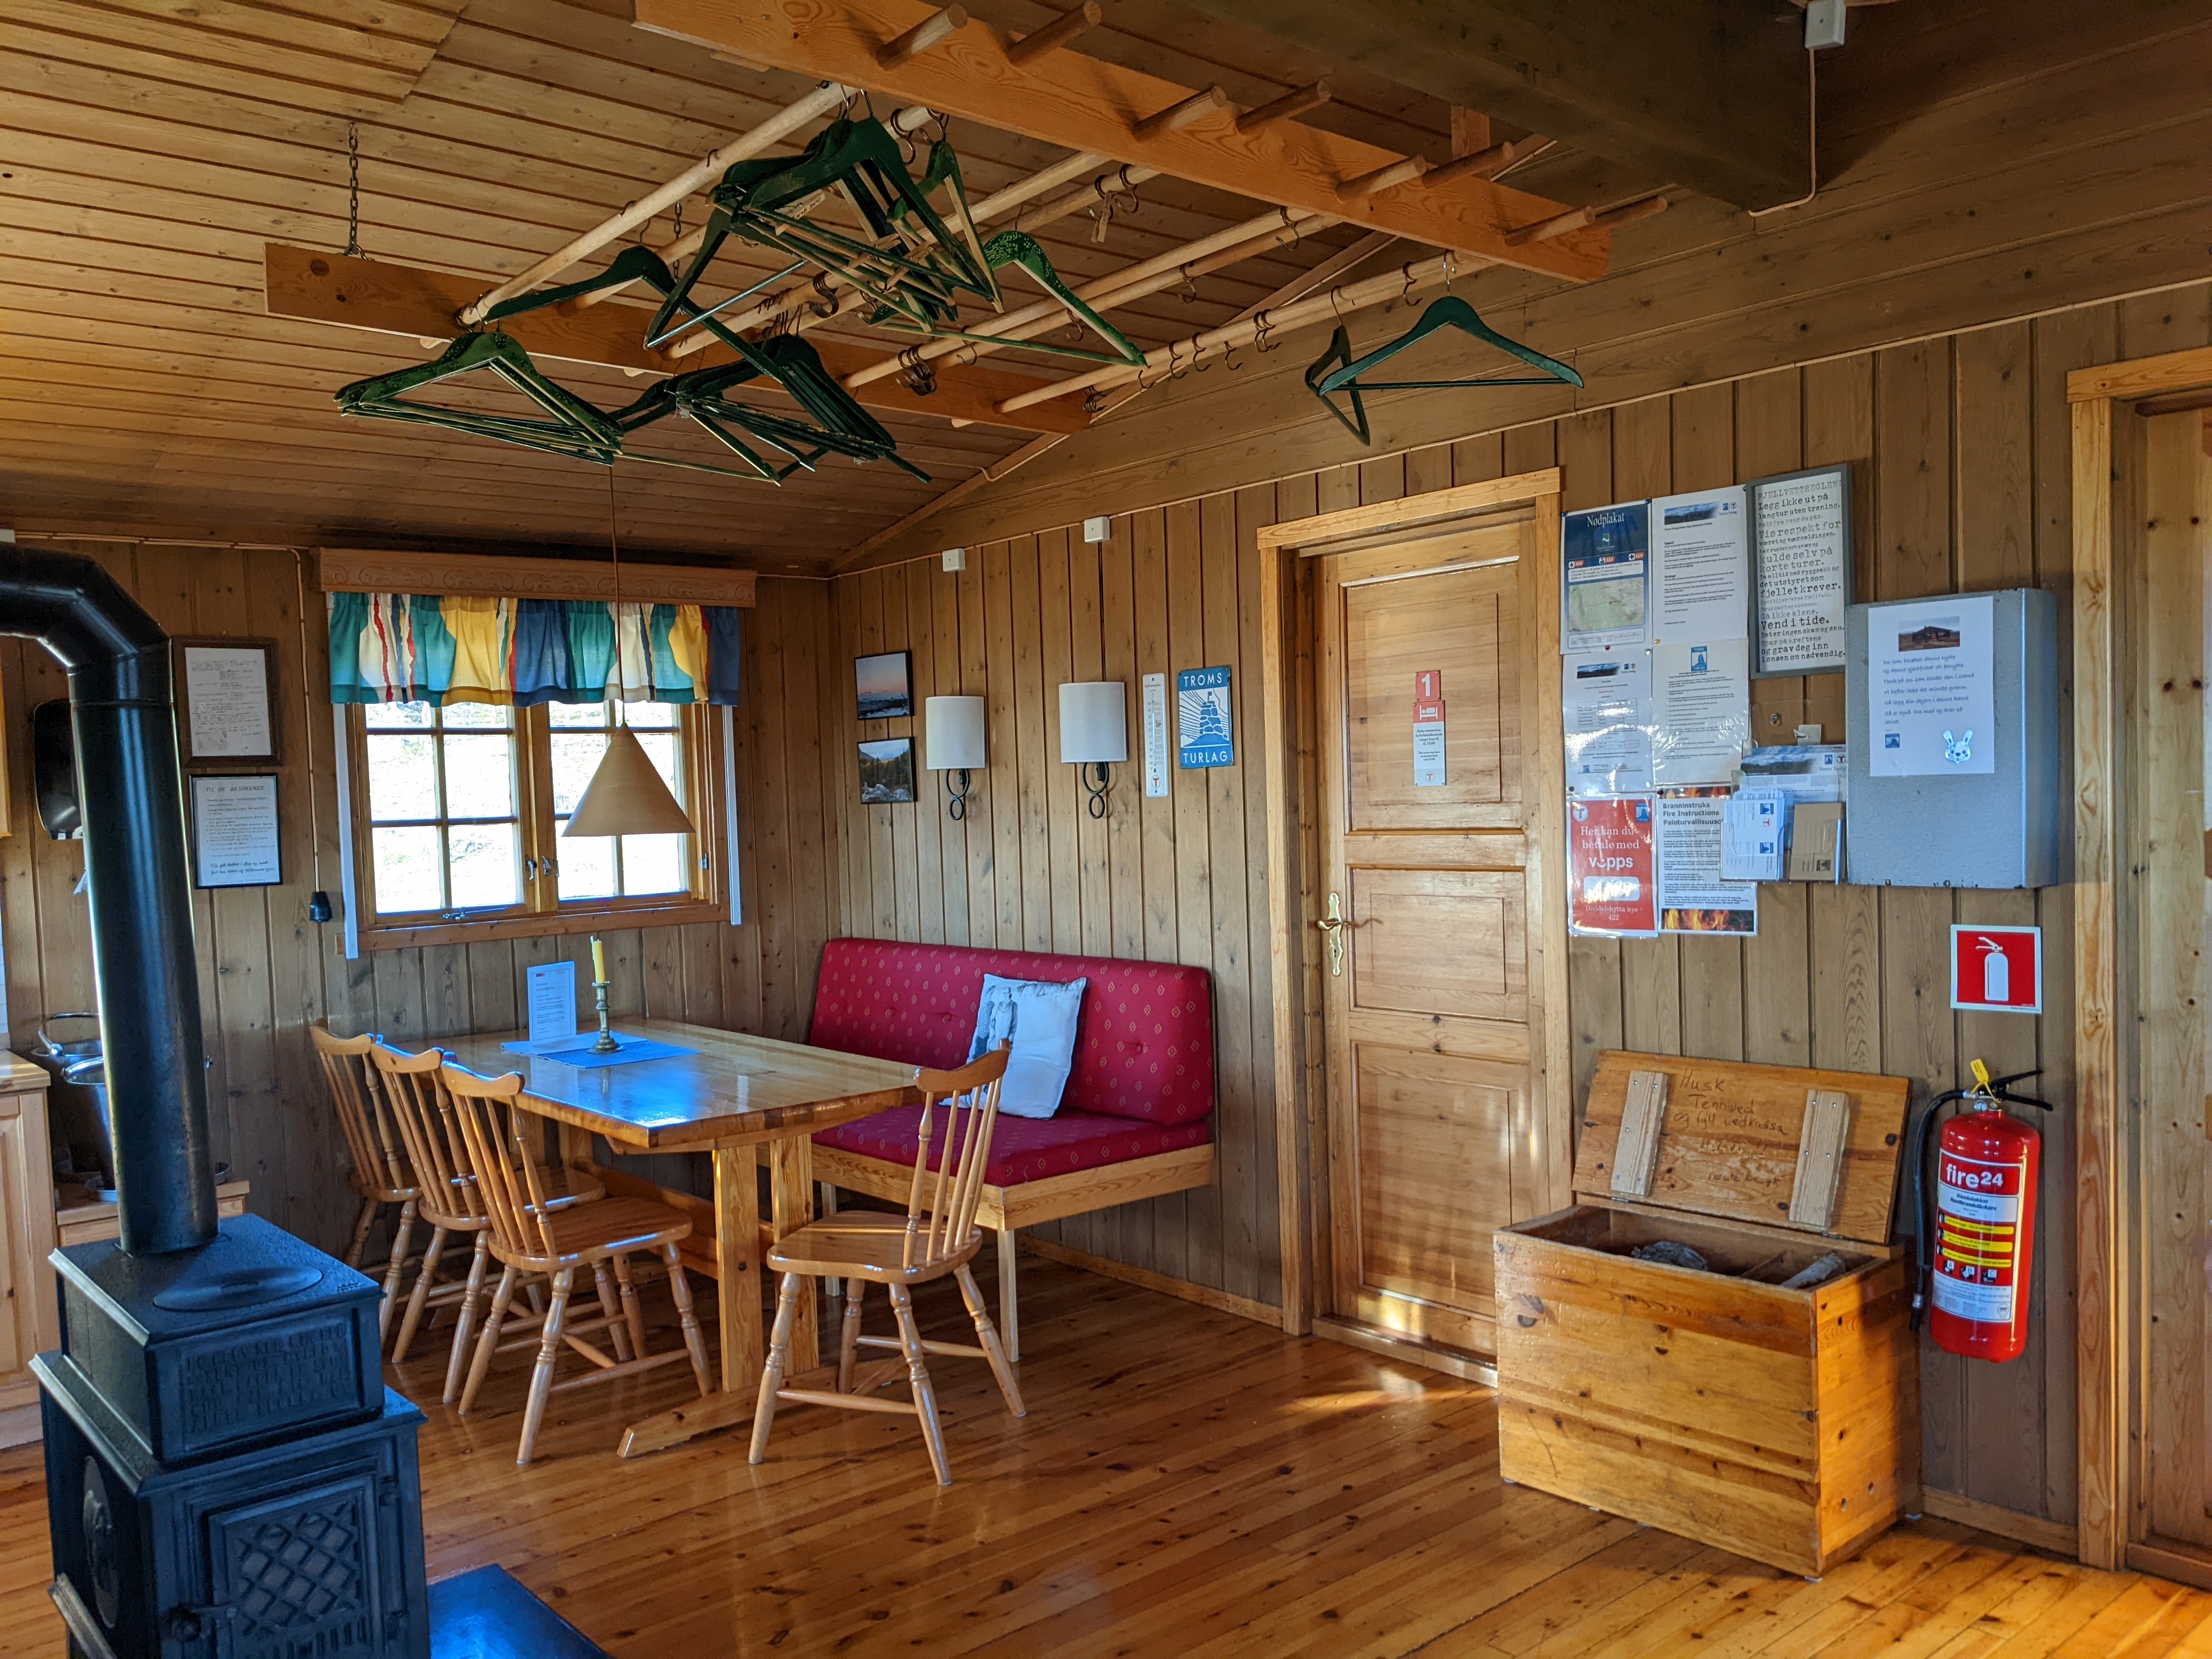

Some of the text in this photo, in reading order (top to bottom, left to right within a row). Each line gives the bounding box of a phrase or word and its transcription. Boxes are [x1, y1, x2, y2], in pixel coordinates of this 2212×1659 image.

[1758, 481, 1841, 499] FJELLVETTREGLEN
[1758, 493, 1829, 510] Legg ikke ut på
[1759, 511, 1788, 520] langtur
[1808, 503, 1840, 511] trening.
[1587, 512, 1624, 527] Nødplakat
[1759, 521, 1841, 539] Vis respekt for
[1787, 532, 1836, 542] værmeldingen.
[1760, 547, 1832, 563] kulde selv på
[1760, 560, 1824, 572] korte turer.
[1774, 576, 1809, 586] utstyret
[1760, 583, 1841, 598] fjellet krever.
[1792, 609, 1818, 617] alene.
[1761, 616, 1829, 630] Vend i tide.
[1773, 646, 1794, 654] grav
[1801, 650, 1845, 659] nødvendig.
[1183, 673, 1222, 687] TROMS
[1421, 674, 1431, 697] 1
[1183, 751, 1228, 764] TURLAG
[1581, 826, 1634, 836] Her kan du
[1582, 839, 1639, 849] betale med
[1679, 1069, 1725, 1092] Husk
[1674, 1112, 1689, 1128] og
[1697, 1111, 1715, 1130] fyll
[1946, 1163, 2003, 1188] fire24
